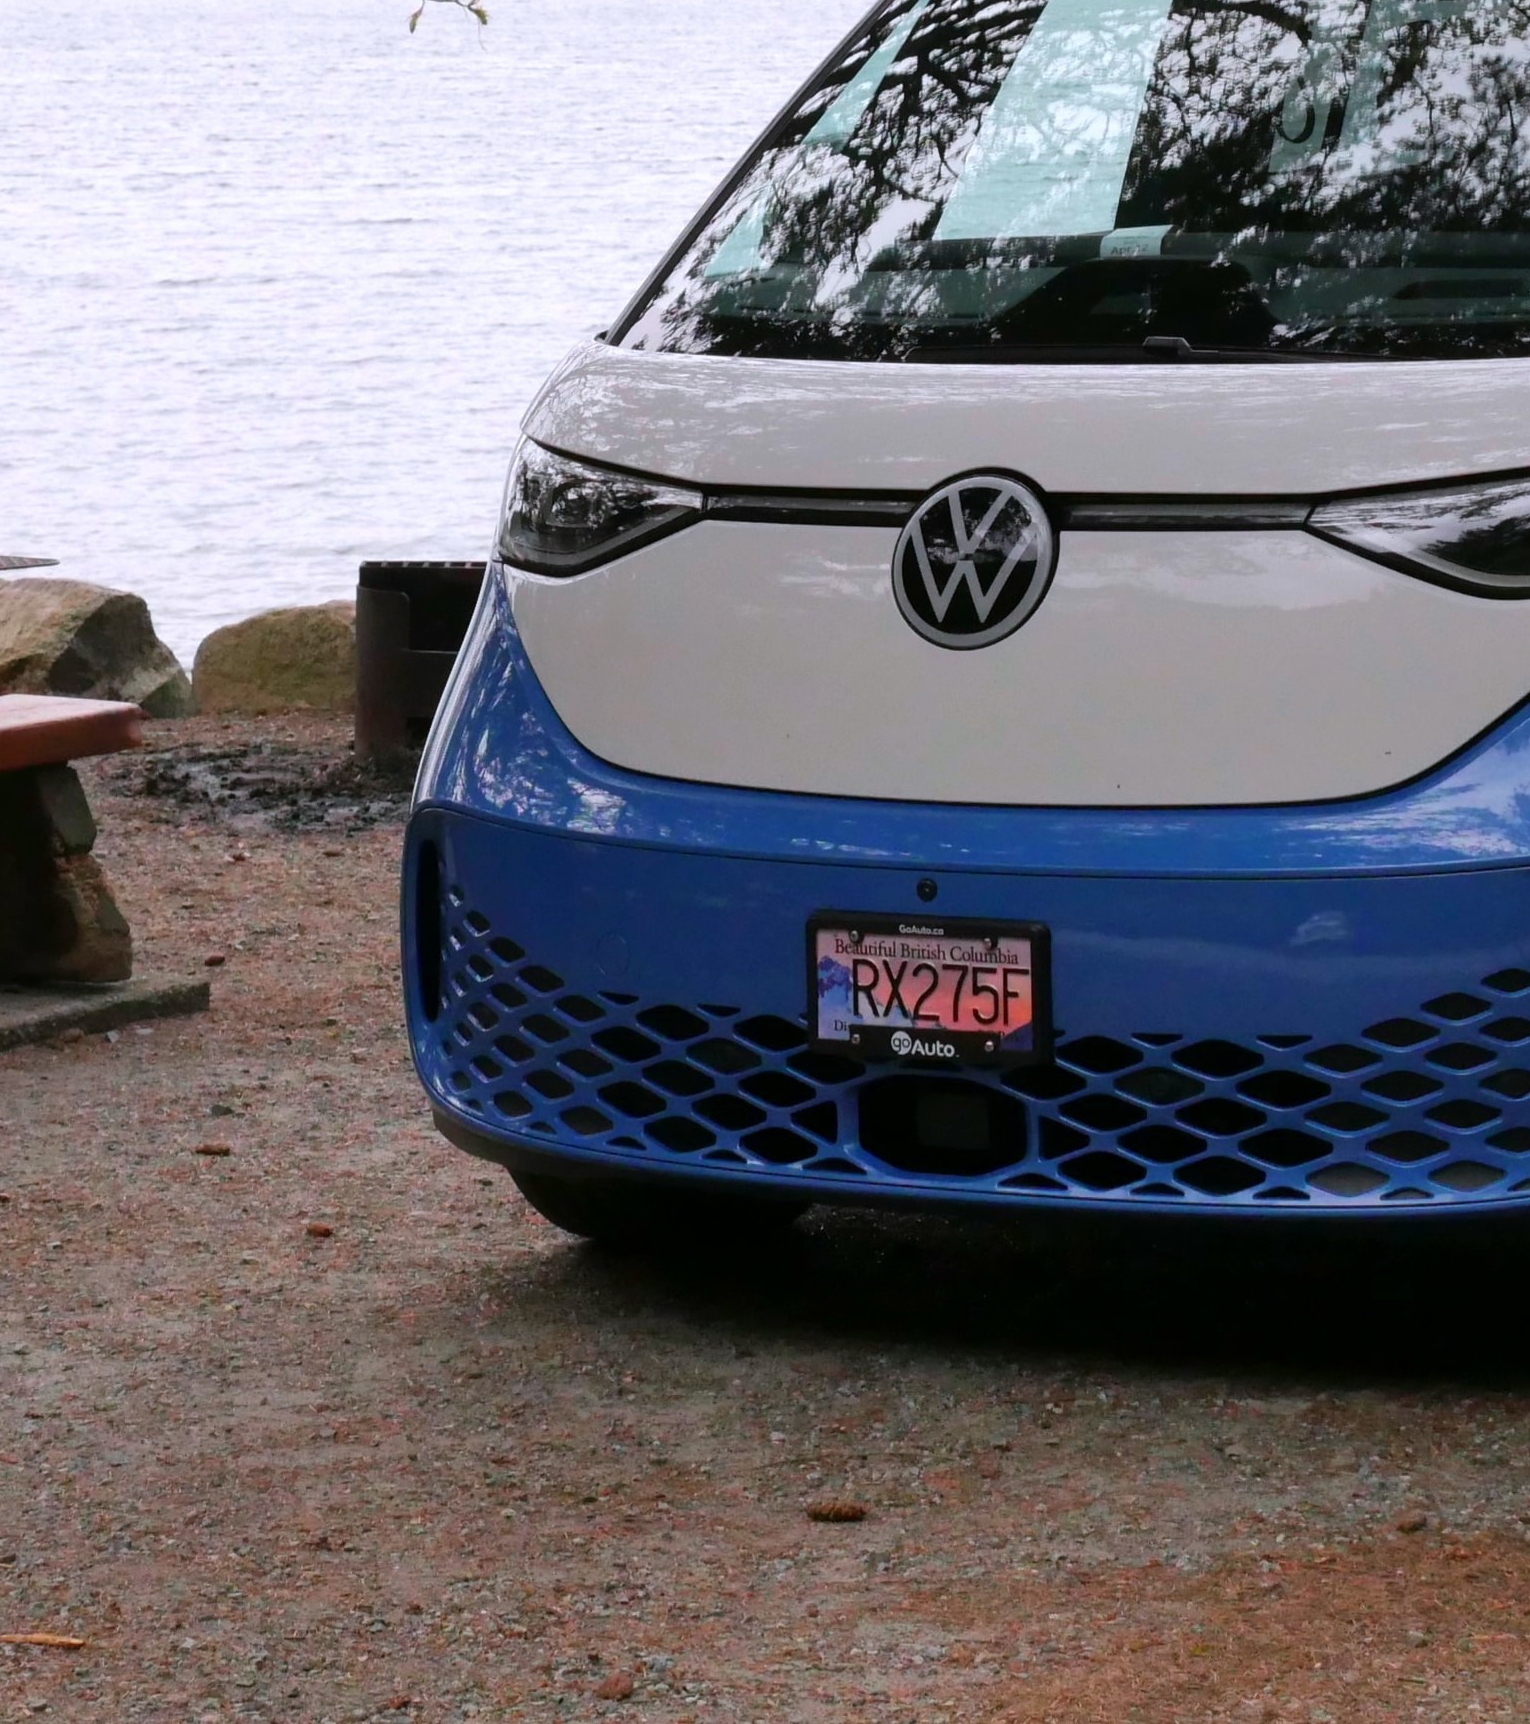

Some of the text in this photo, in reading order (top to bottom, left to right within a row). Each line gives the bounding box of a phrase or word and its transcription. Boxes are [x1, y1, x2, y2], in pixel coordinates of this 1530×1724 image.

[898, 924, 945, 936] GoAuto.ca
[834, 937, 1019, 965] Beautiful British Columbia
[851, 958, 1030, 1026] RX275F
